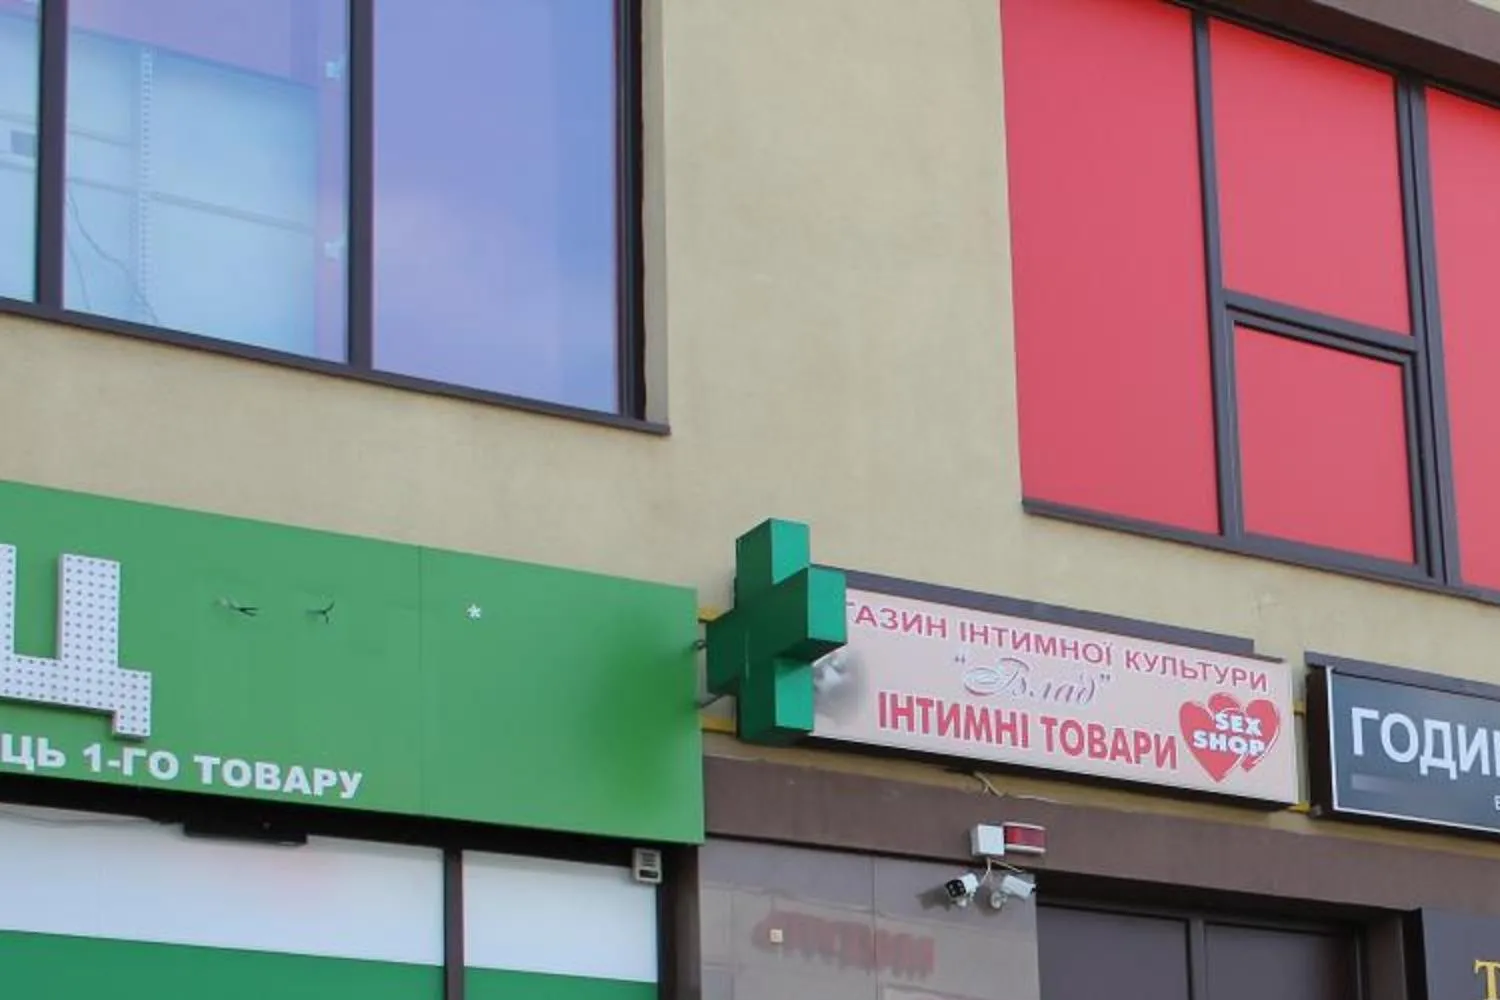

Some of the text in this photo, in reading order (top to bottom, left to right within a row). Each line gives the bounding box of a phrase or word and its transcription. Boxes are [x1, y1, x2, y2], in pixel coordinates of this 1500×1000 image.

[846, 601, 1268, 692] АЗИН ІНТИМНОЇ КУЛЬТУРИ
[878, 692, 1178, 770] ІНТИМНІ ТОВАРИ
[1193, 730, 1266, 757] SHOP
[1213, 710, 1262, 737] SEX
[83, 743, 180, 781] 1-ГО
[194, 754, 363, 799] ТОВАРУ
